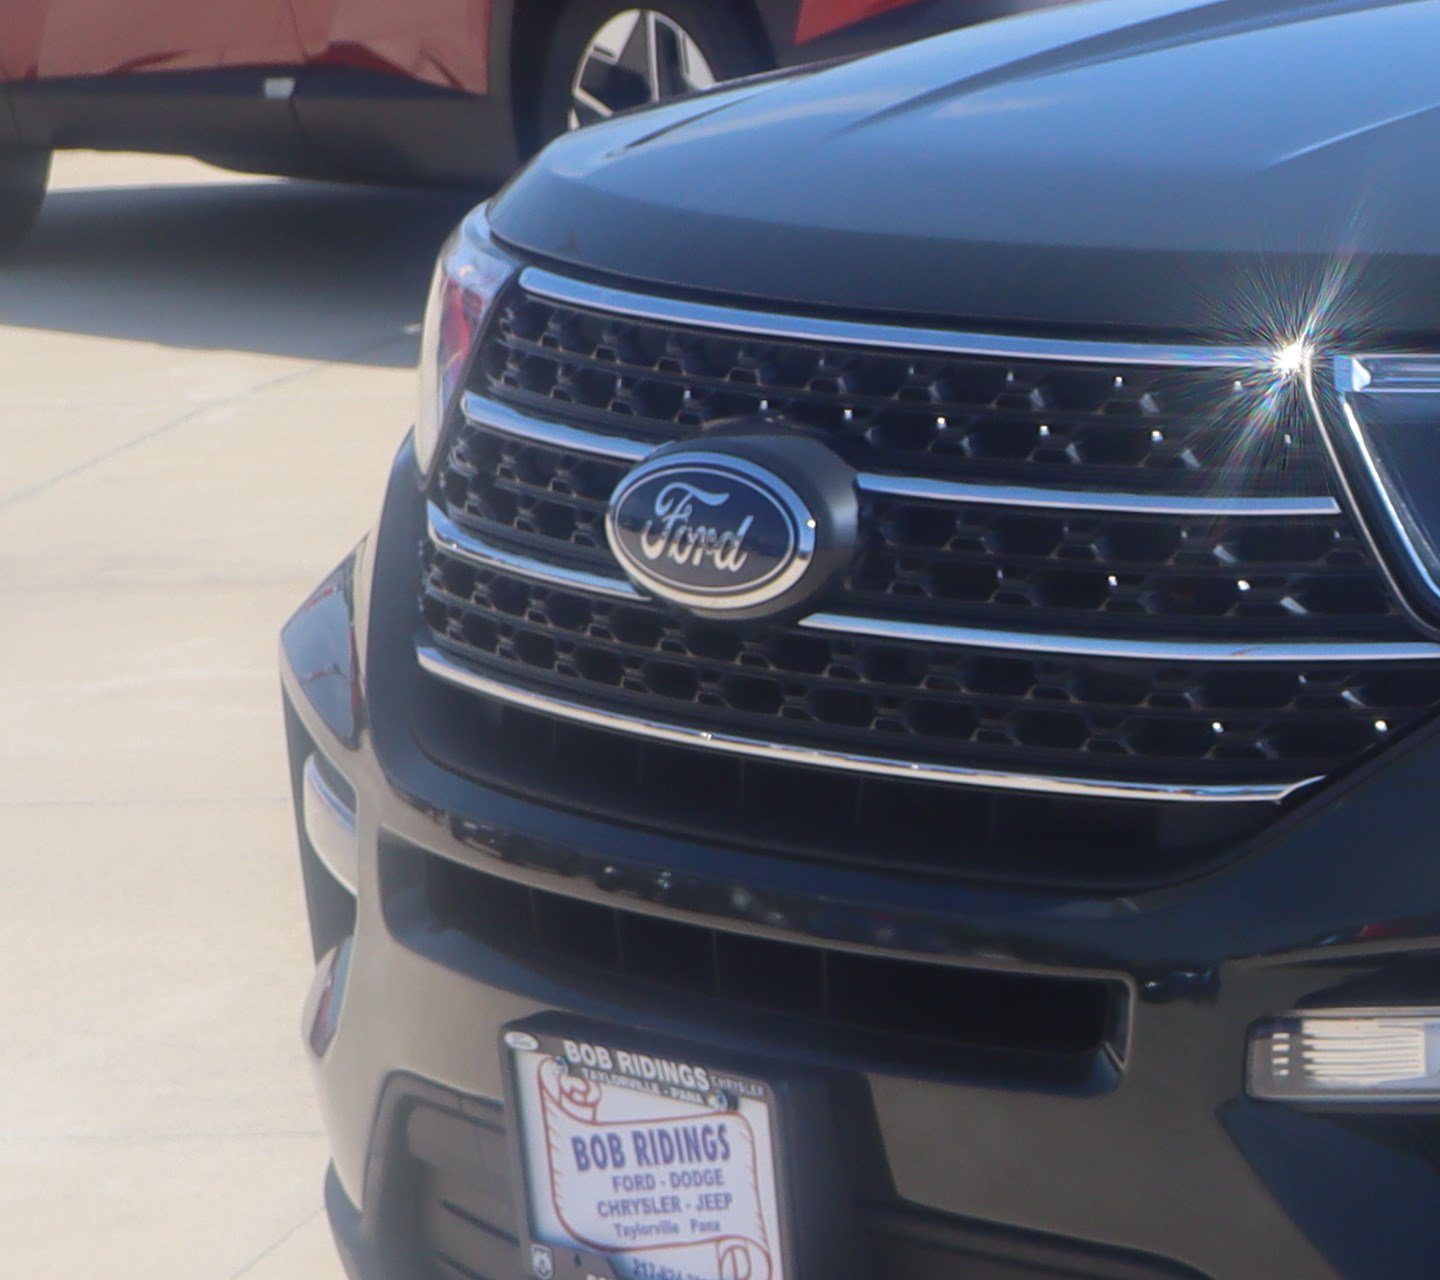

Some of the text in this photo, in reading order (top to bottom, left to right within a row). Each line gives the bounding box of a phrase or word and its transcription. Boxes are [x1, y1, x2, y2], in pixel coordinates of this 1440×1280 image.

[641, 481, 754, 572] Ford
[563, 1039, 710, 1091] BOB RIDINGS
[571, 1123, 731, 1171] BOB RIDINGS
[612, 1173, 656, 1193] FORD
[669, 1168, 725, 1189] DODGE
[597, 1195, 682, 1218] CHRYSLER
[695, 1192, 733, 1211] JEEP
[614, 1221, 680, 1240] Taylorville
